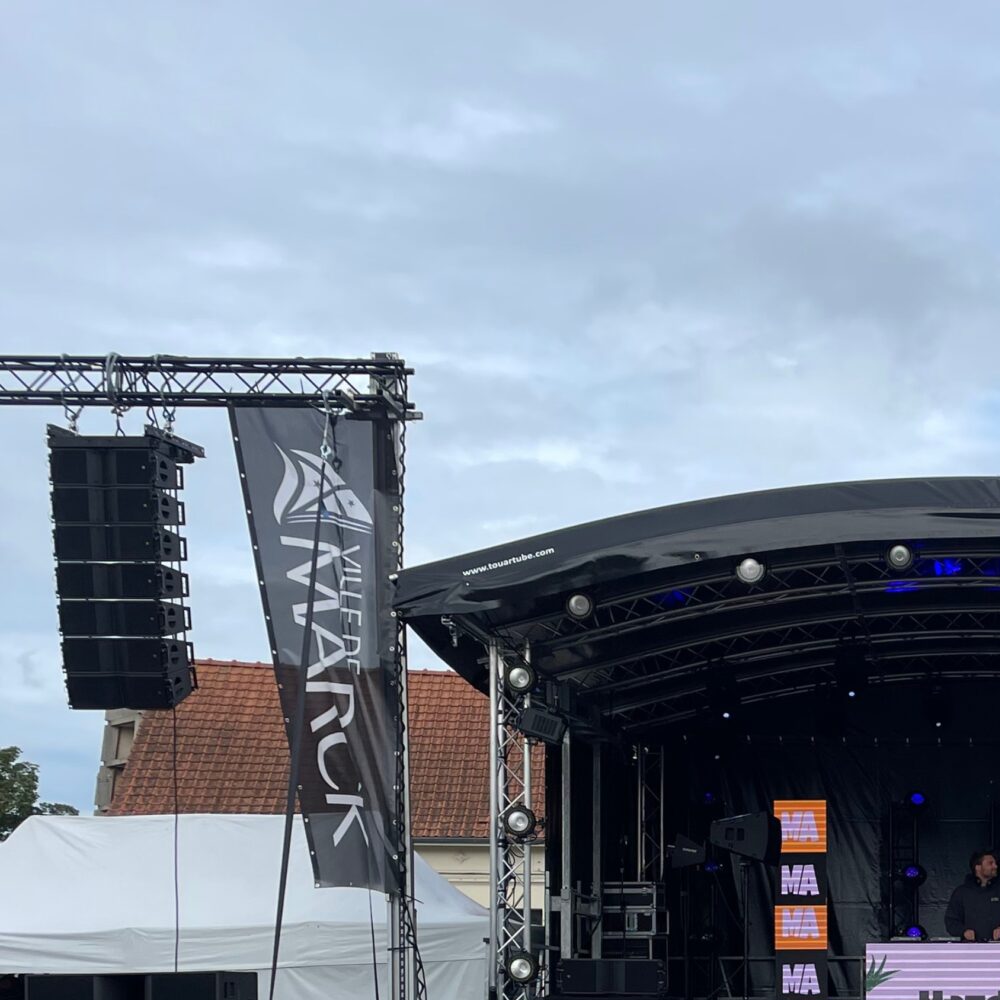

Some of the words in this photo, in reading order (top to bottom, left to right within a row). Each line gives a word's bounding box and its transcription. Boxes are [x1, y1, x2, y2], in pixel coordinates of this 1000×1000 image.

[462, 547, 555, 576] www.touartube.com
[279, 535, 370, 849] MARCK
[781, 811, 820, 842] MA
[781, 864, 820, 896] MA
[781, 907, 820, 939] MA
[782, 963, 821, 995] MA
